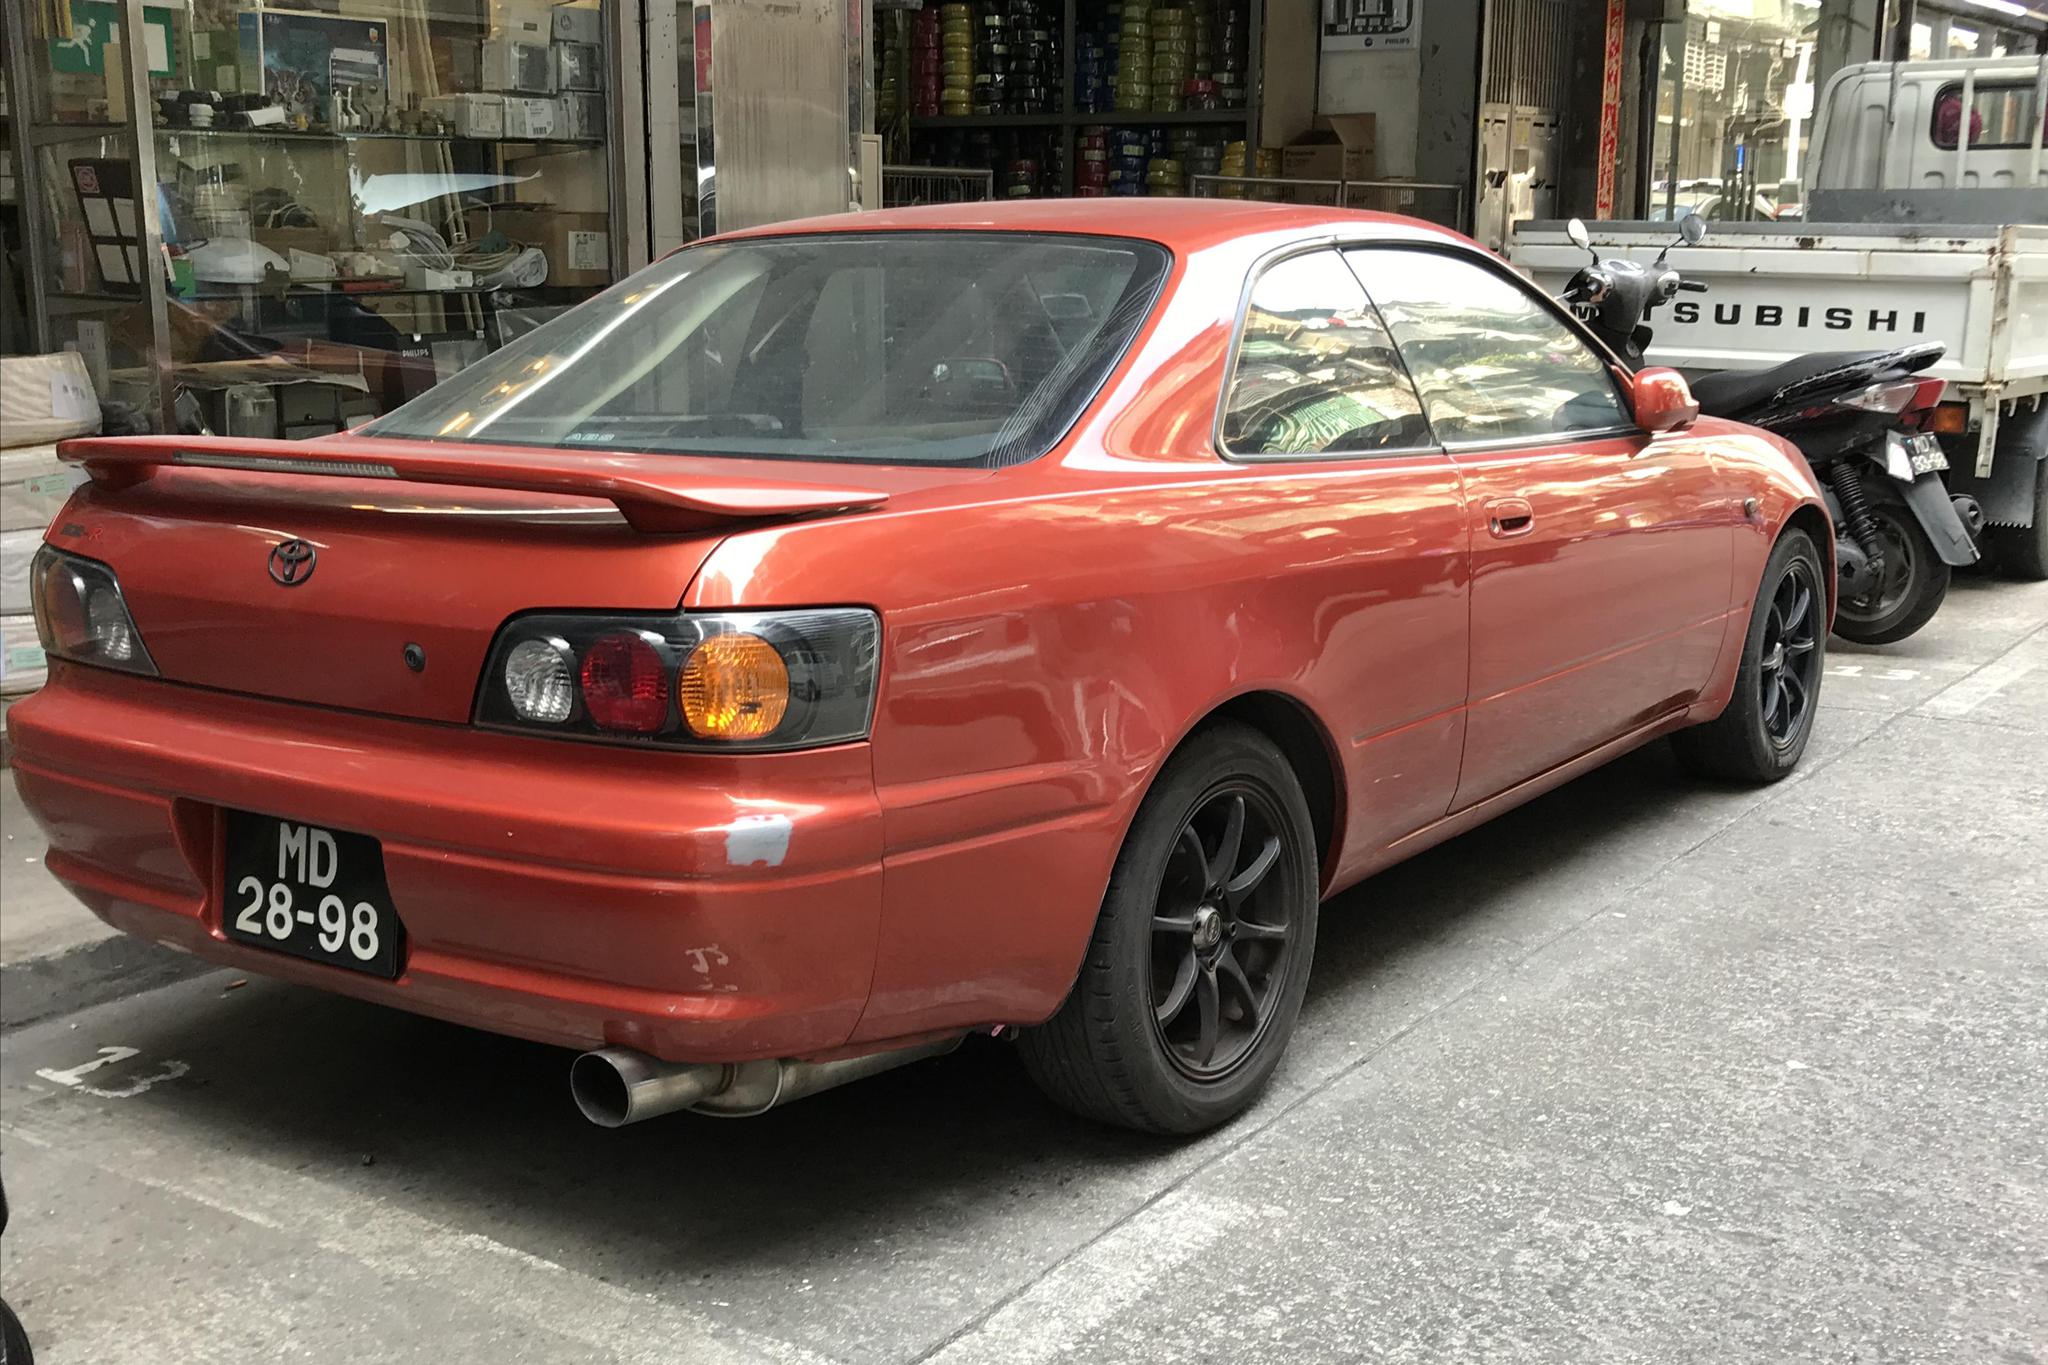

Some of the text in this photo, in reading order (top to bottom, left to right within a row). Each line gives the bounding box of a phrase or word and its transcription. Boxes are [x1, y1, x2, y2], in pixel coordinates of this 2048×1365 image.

[1385, 37, 1410, 45] PHILIPS
[402, 348, 429, 358] PHILIPS
[278, 821, 338, 889] MD
[235, 875, 379, 961] 28-98
